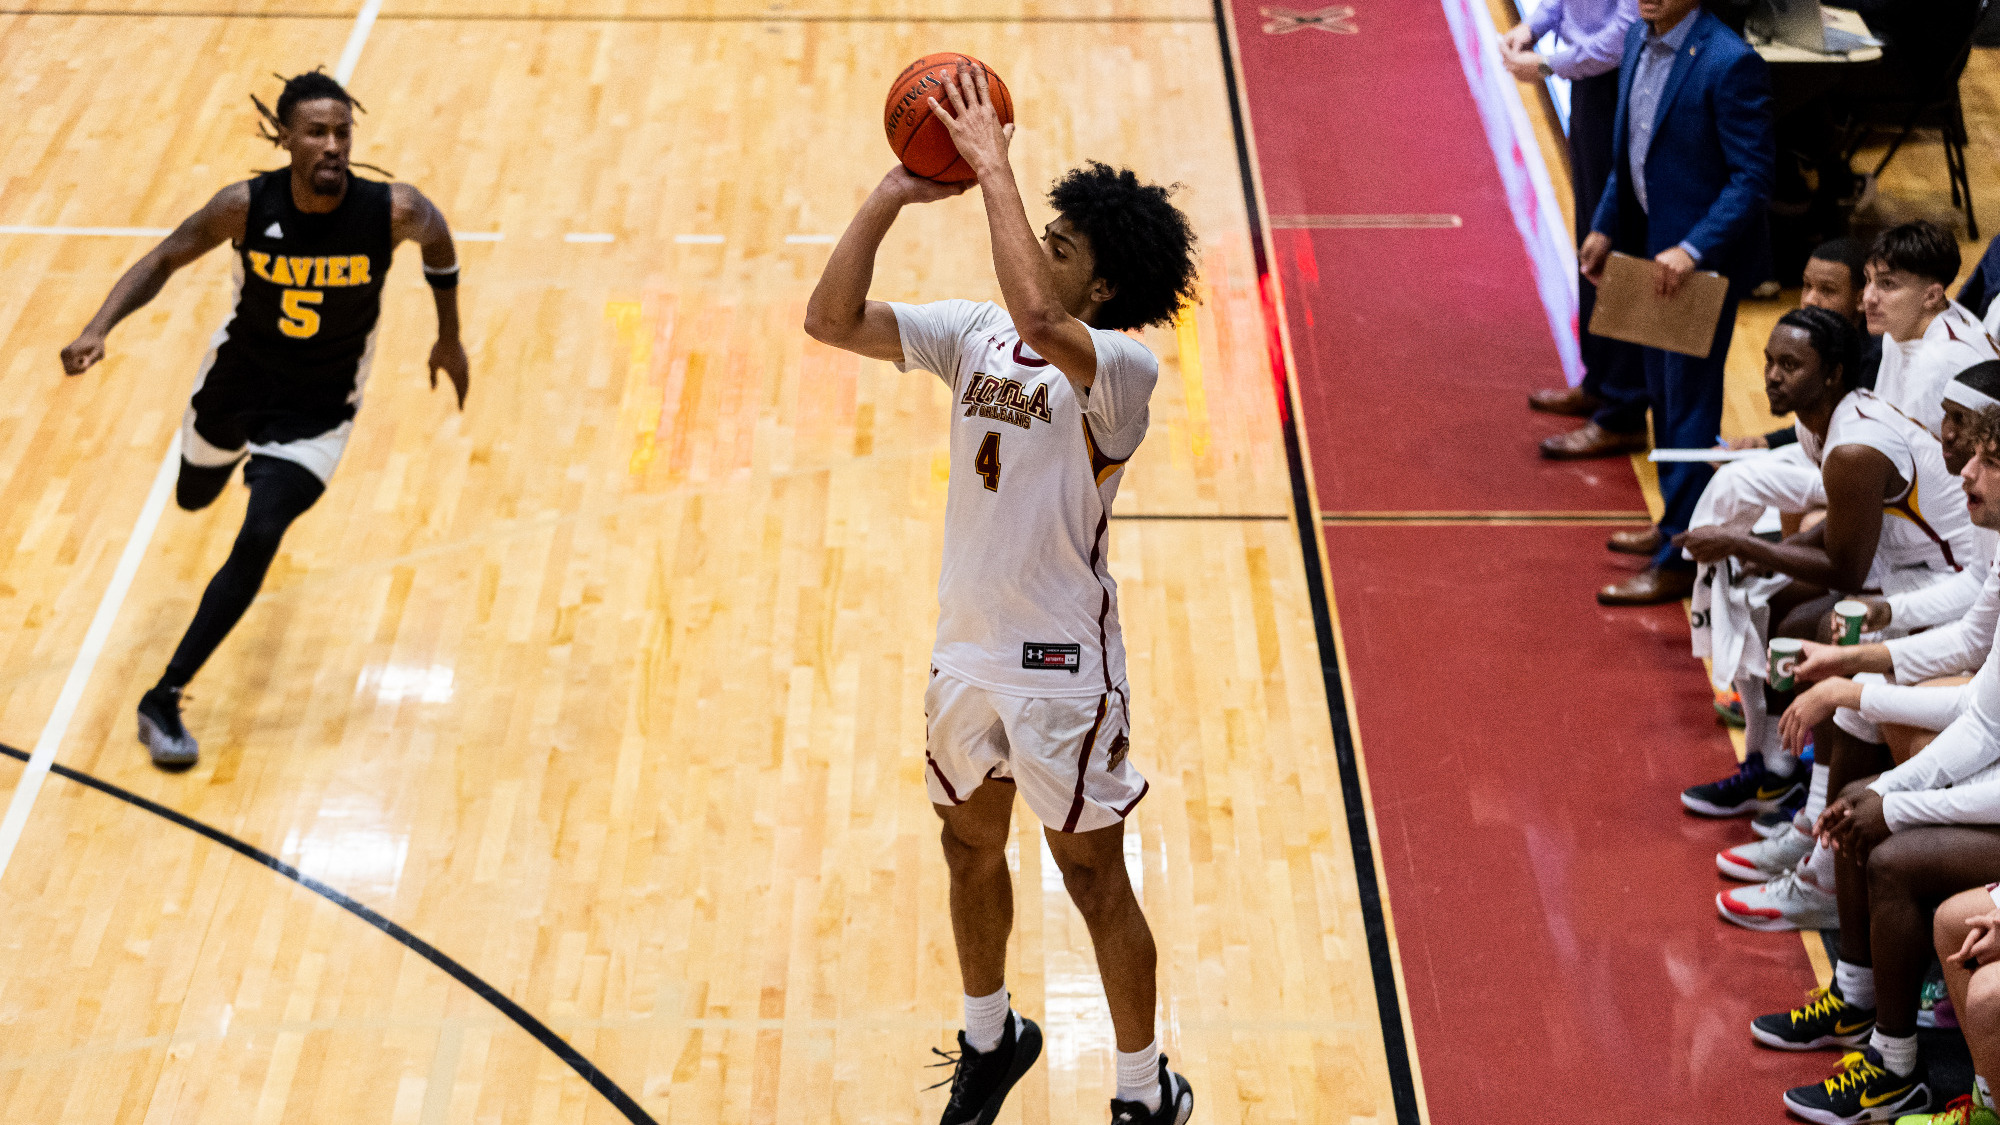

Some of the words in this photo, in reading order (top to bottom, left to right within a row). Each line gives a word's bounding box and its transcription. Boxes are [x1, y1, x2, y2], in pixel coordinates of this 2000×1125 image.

[248, 250, 372, 287] XAVIER
[278, 288, 324, 339] 5
[961, 371, 1052, 424] LOOLA
[978, 404, 1032, 430] ORLEANS
[975, 431, 1002, 493] 4
